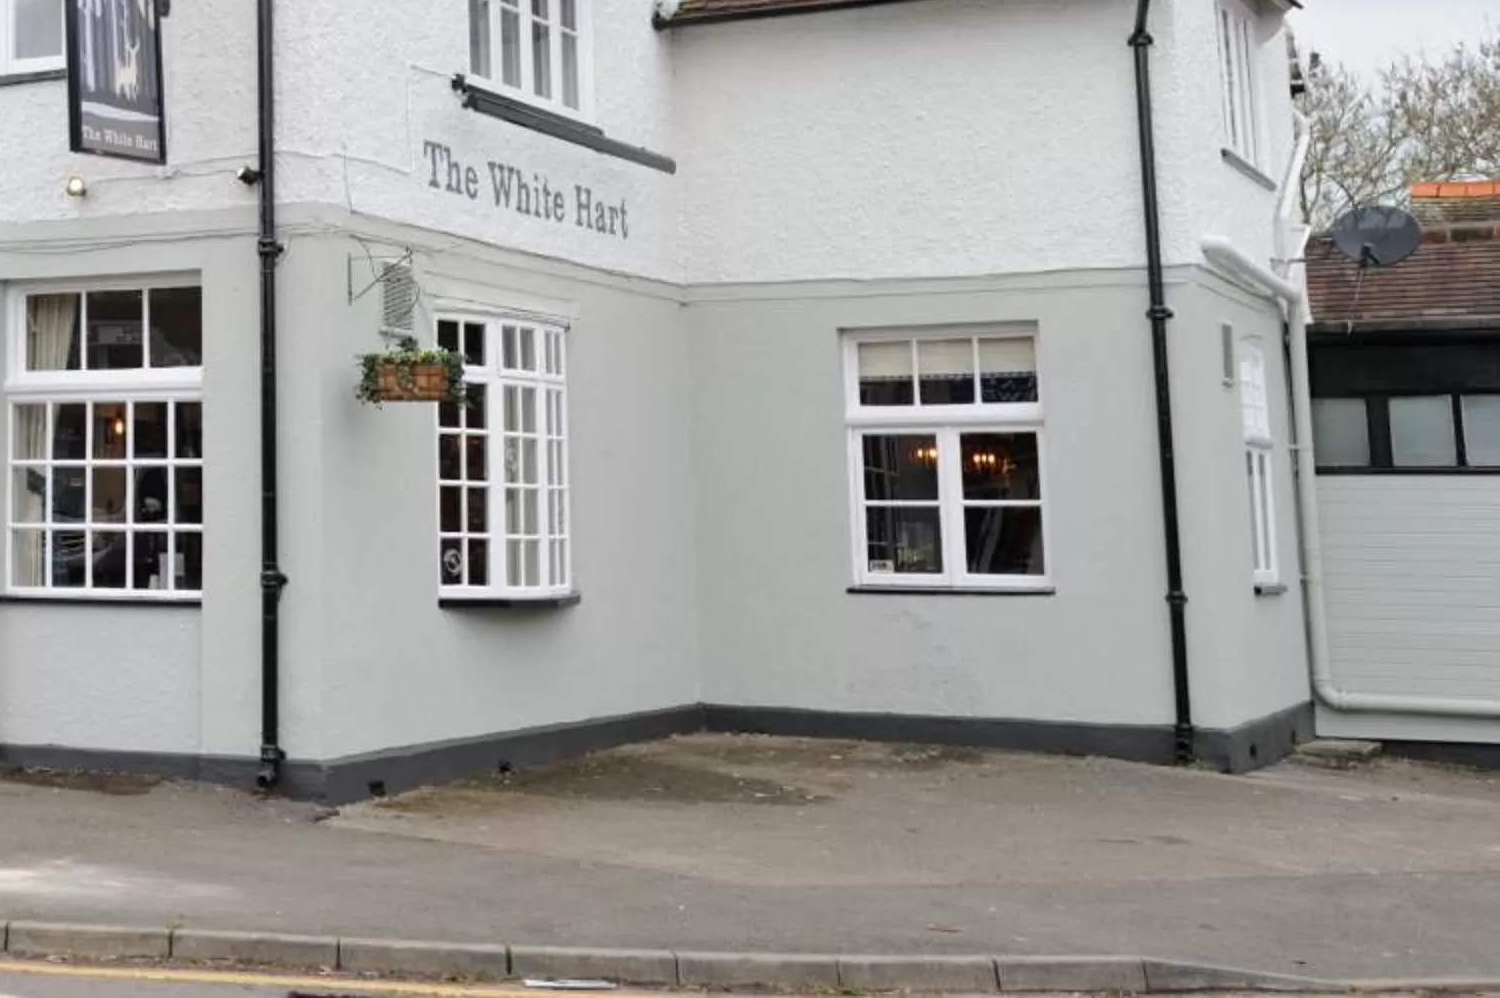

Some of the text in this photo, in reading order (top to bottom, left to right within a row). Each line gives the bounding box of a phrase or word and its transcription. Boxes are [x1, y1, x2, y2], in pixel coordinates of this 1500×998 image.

[423, 139, 629, 240] The White Hart
